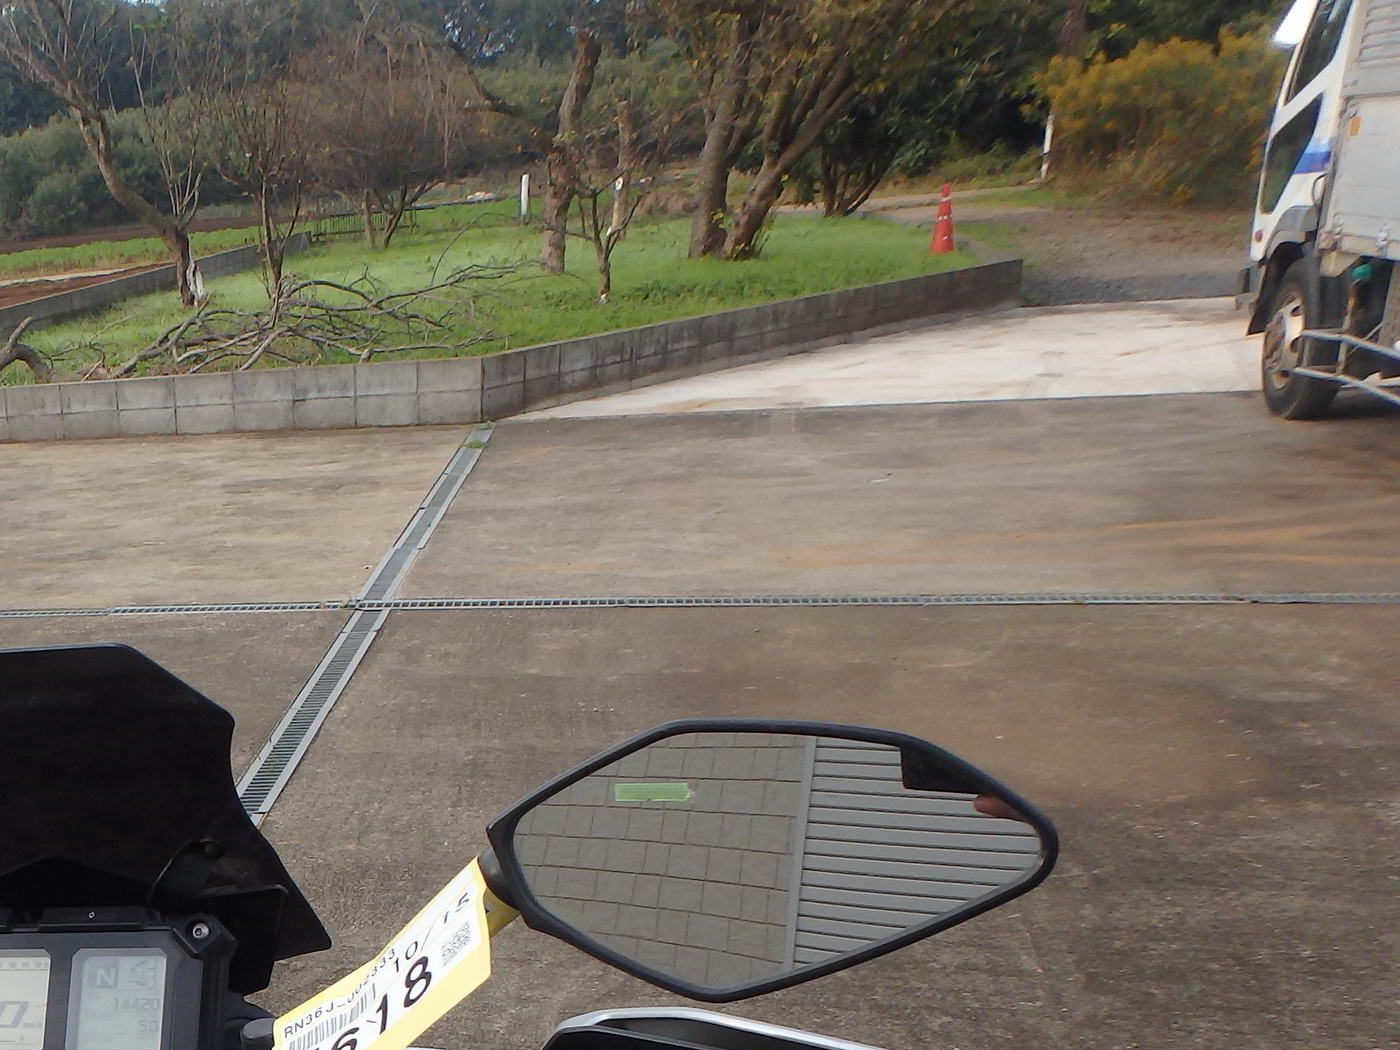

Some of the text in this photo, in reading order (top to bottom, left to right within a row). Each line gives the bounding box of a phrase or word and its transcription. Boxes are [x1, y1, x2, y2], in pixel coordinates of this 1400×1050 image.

[392, 892, 470, 974] 10/15
[96, 967, 117, 987] N
[113, 998, 160, 1011] 14420
[138, 1020, 158, 1032] 50
